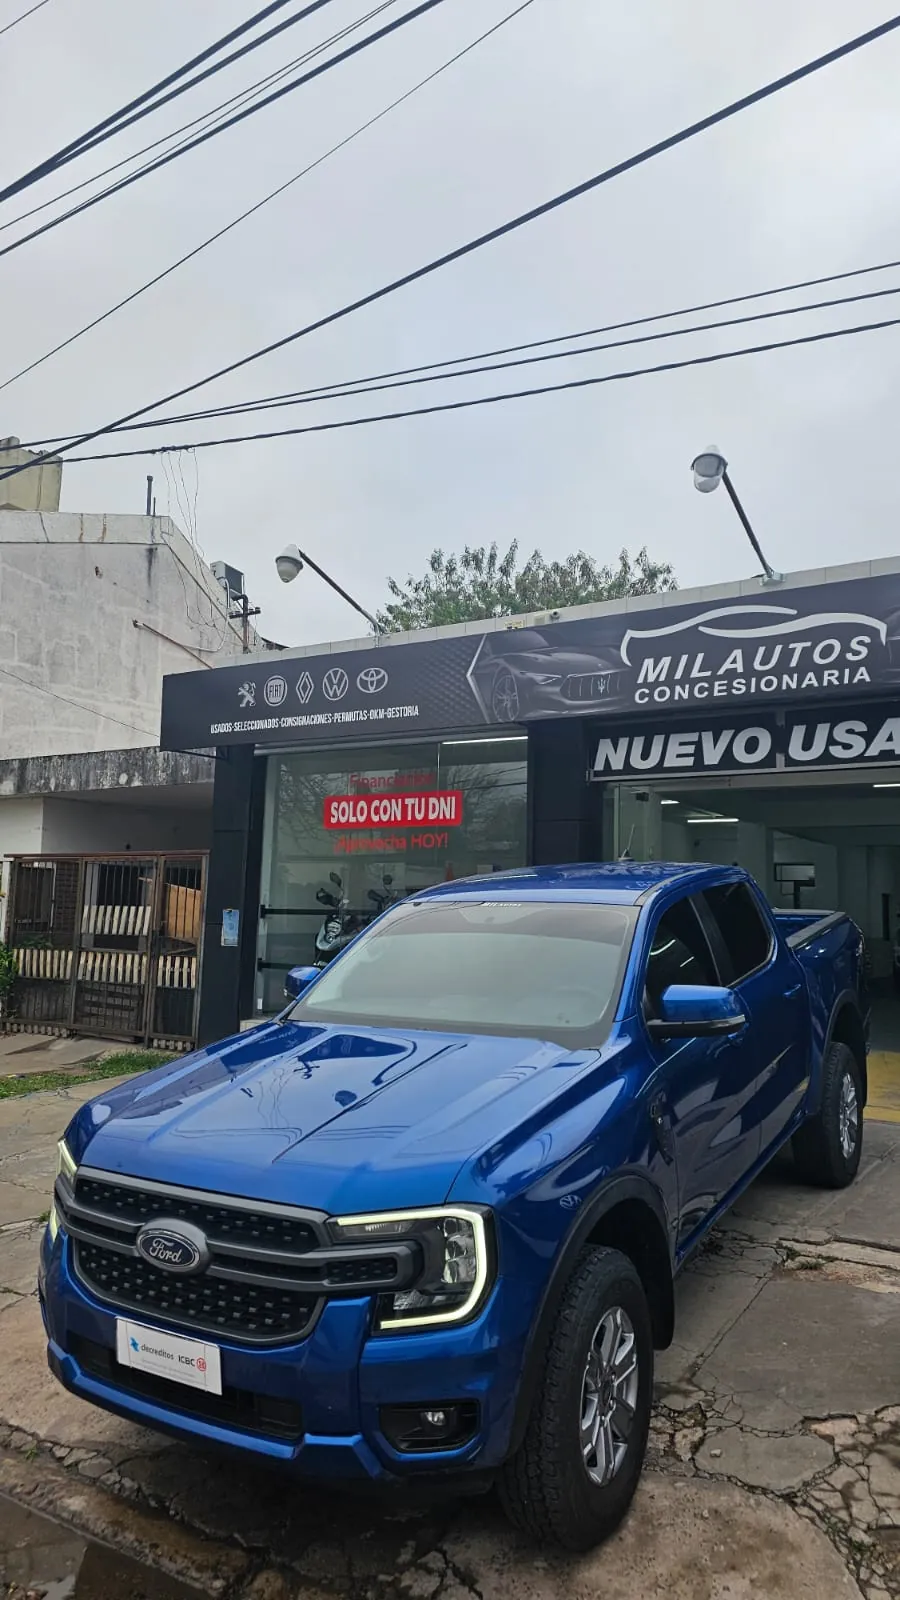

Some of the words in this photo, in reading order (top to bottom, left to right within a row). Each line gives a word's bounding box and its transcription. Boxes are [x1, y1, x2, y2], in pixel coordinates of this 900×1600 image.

[268, 684, 283, 698] FIAT
[634, 666, 871, 704] CONCESIONARIA
[593, 726, 772, 771] NUEVO
[787, 717, 900, 761] USA
[330, 801, 368, 823] SOLO
[370, 799, 402, 822] CON
[405, 797, 425, 820] TU
[428, 796, 456, 820] DNI
[411, 832, 449, 849] HOY!
[149, 1238, 182, 1263] Ford
[141, 1343, 175, 1361] decreditos
[178, 1354, 196, 1367] ICBC
